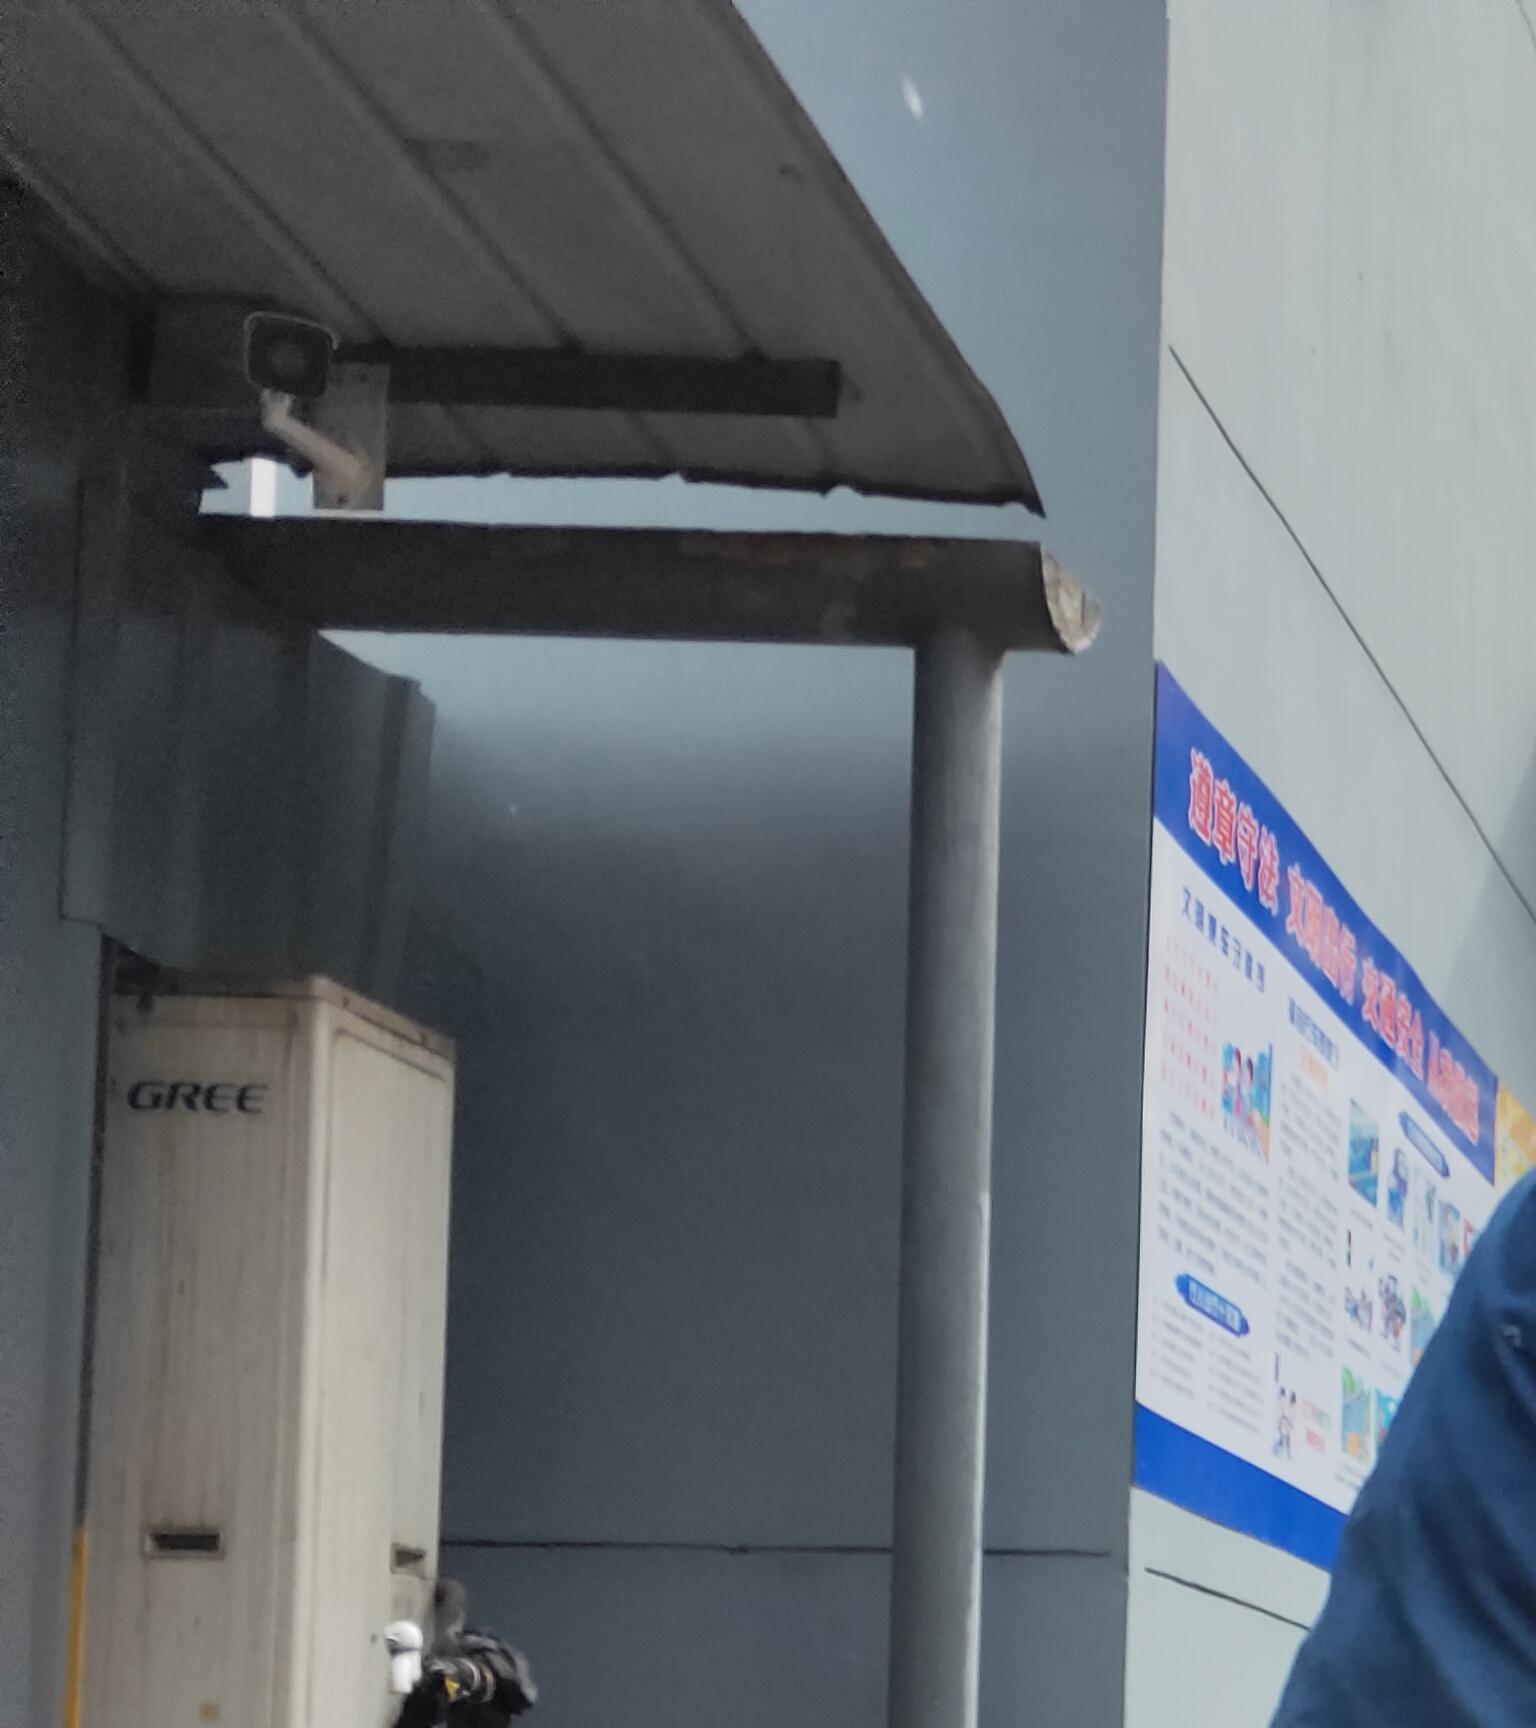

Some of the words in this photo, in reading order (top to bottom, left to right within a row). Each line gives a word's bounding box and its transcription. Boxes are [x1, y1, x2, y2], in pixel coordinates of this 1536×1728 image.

[1188, 747, 1279, 917] 遵章守法
[1362, 957, 1424, 1080] 交通安全
[127, 1080, 269, 1114] GREE
